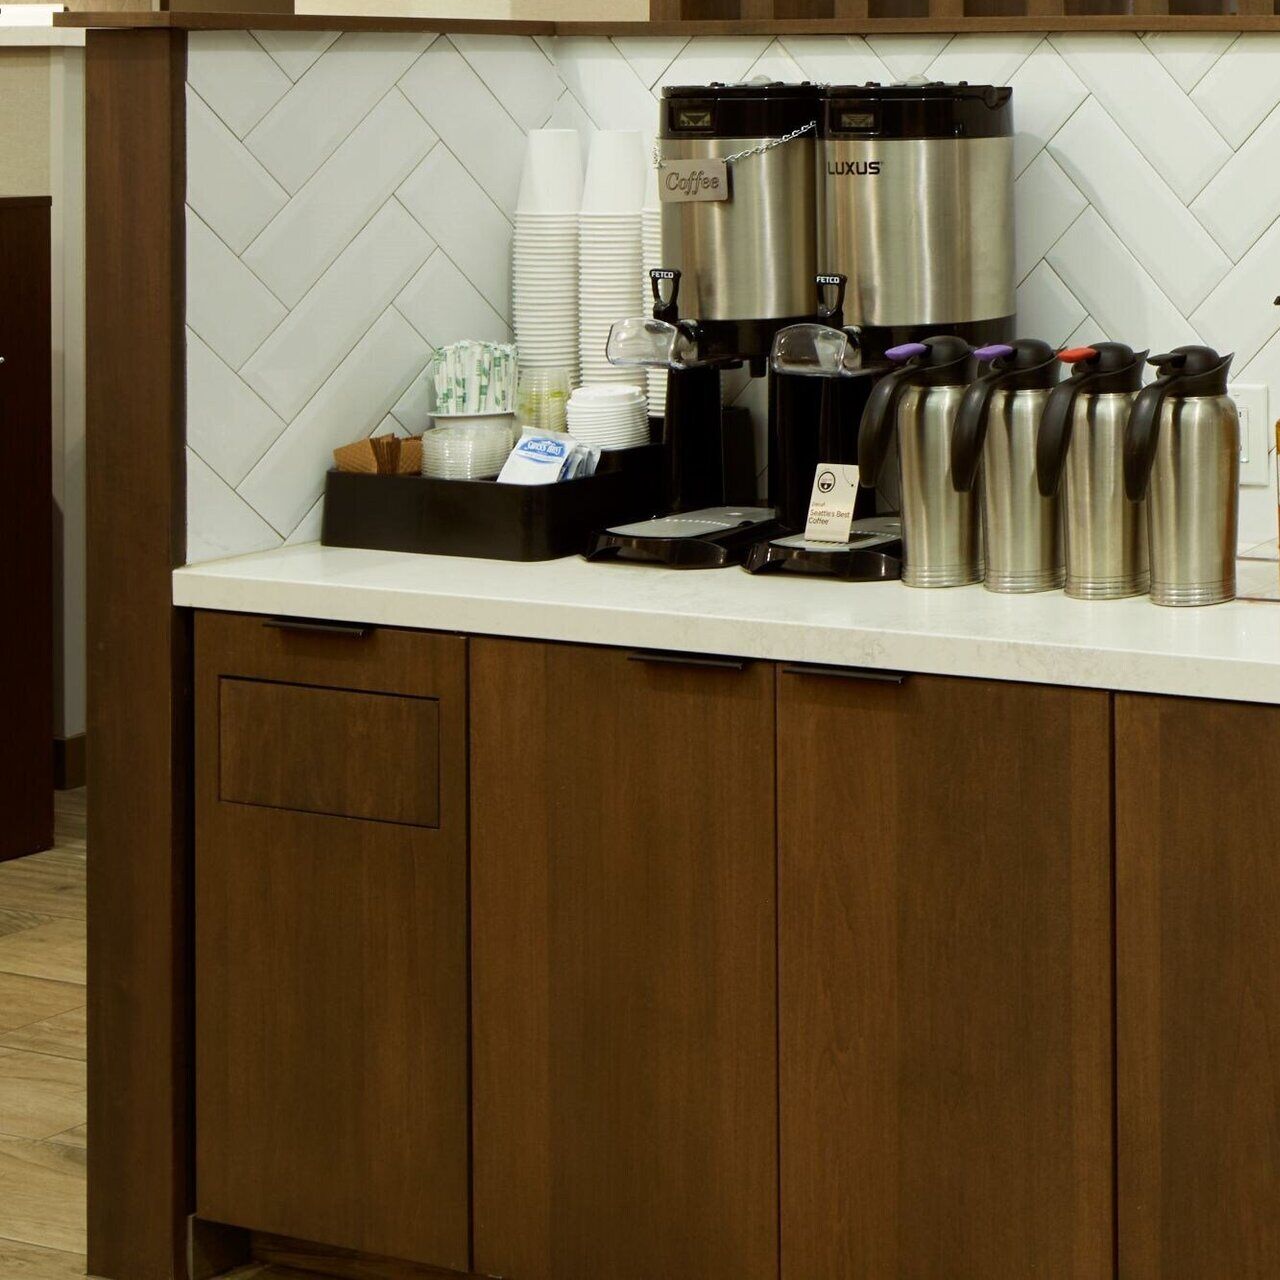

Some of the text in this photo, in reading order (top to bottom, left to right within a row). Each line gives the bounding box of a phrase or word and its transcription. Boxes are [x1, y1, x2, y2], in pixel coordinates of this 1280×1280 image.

[828, 161, 881, 176] LUXUS
[665, 170, 720, 196] Coffee
[651, 270, 674, 279] FETCO
[816, 275, 840, 284] FETCO
[836, 510, 851, 518] Best
[809, 517, 829, 525] Coffee
